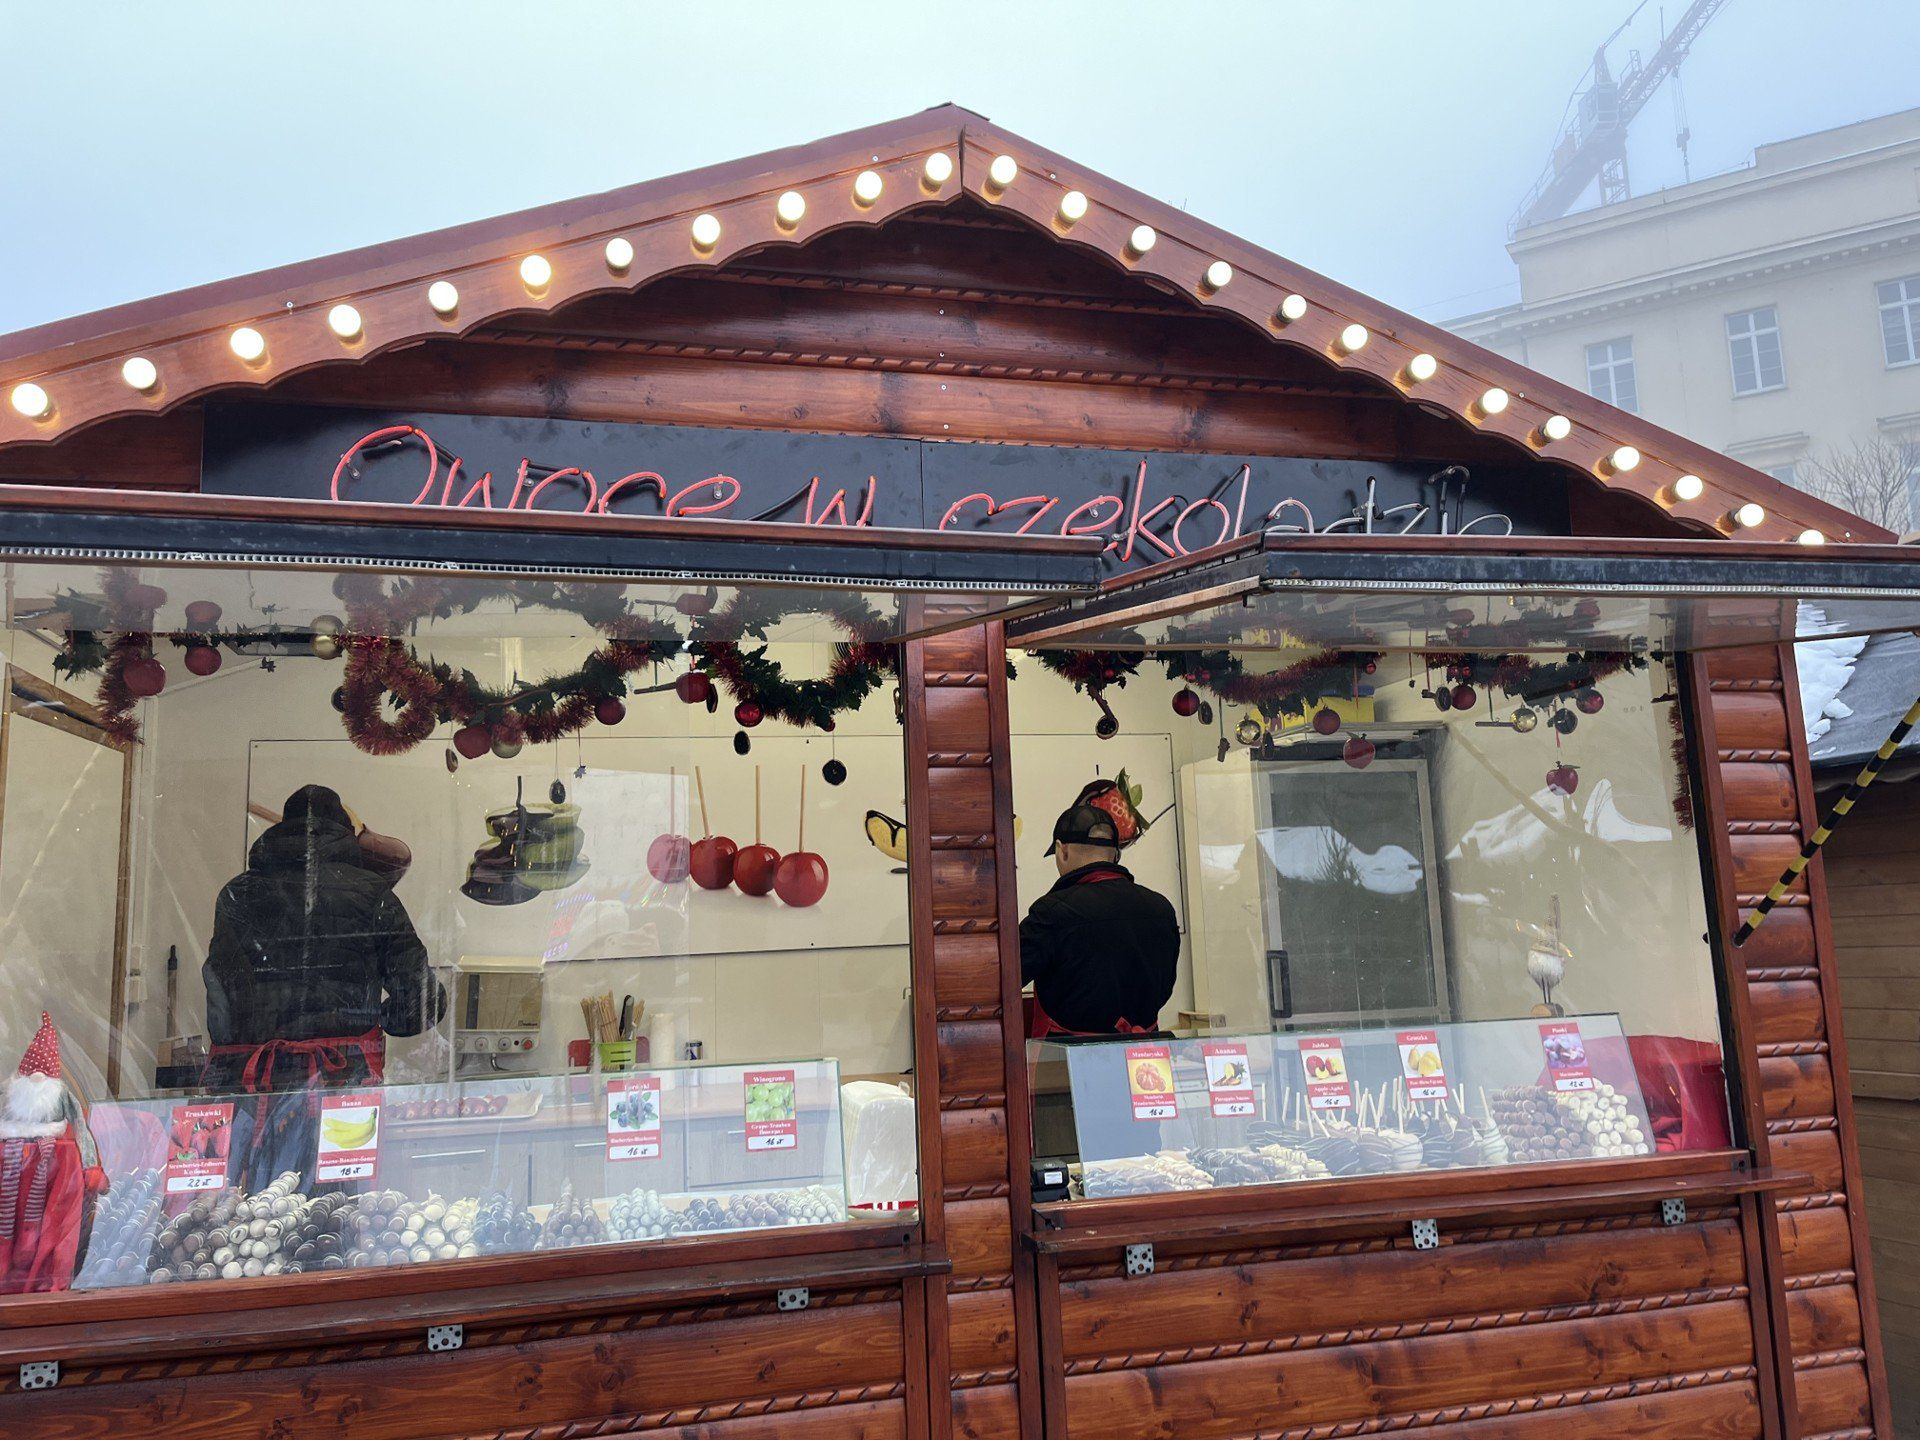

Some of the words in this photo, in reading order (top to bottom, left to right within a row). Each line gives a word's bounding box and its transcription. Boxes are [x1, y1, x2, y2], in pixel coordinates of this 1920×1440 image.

[330, 425, 741, 518] Owoce
[804, 475, 878, 528] w
[184, 1109, 222, 1118] Truskawki
[627, 1147, 638, 1156] 16
[340, 1167, 351, 1176] 18
[187, 1178, 201, 1188] 22
